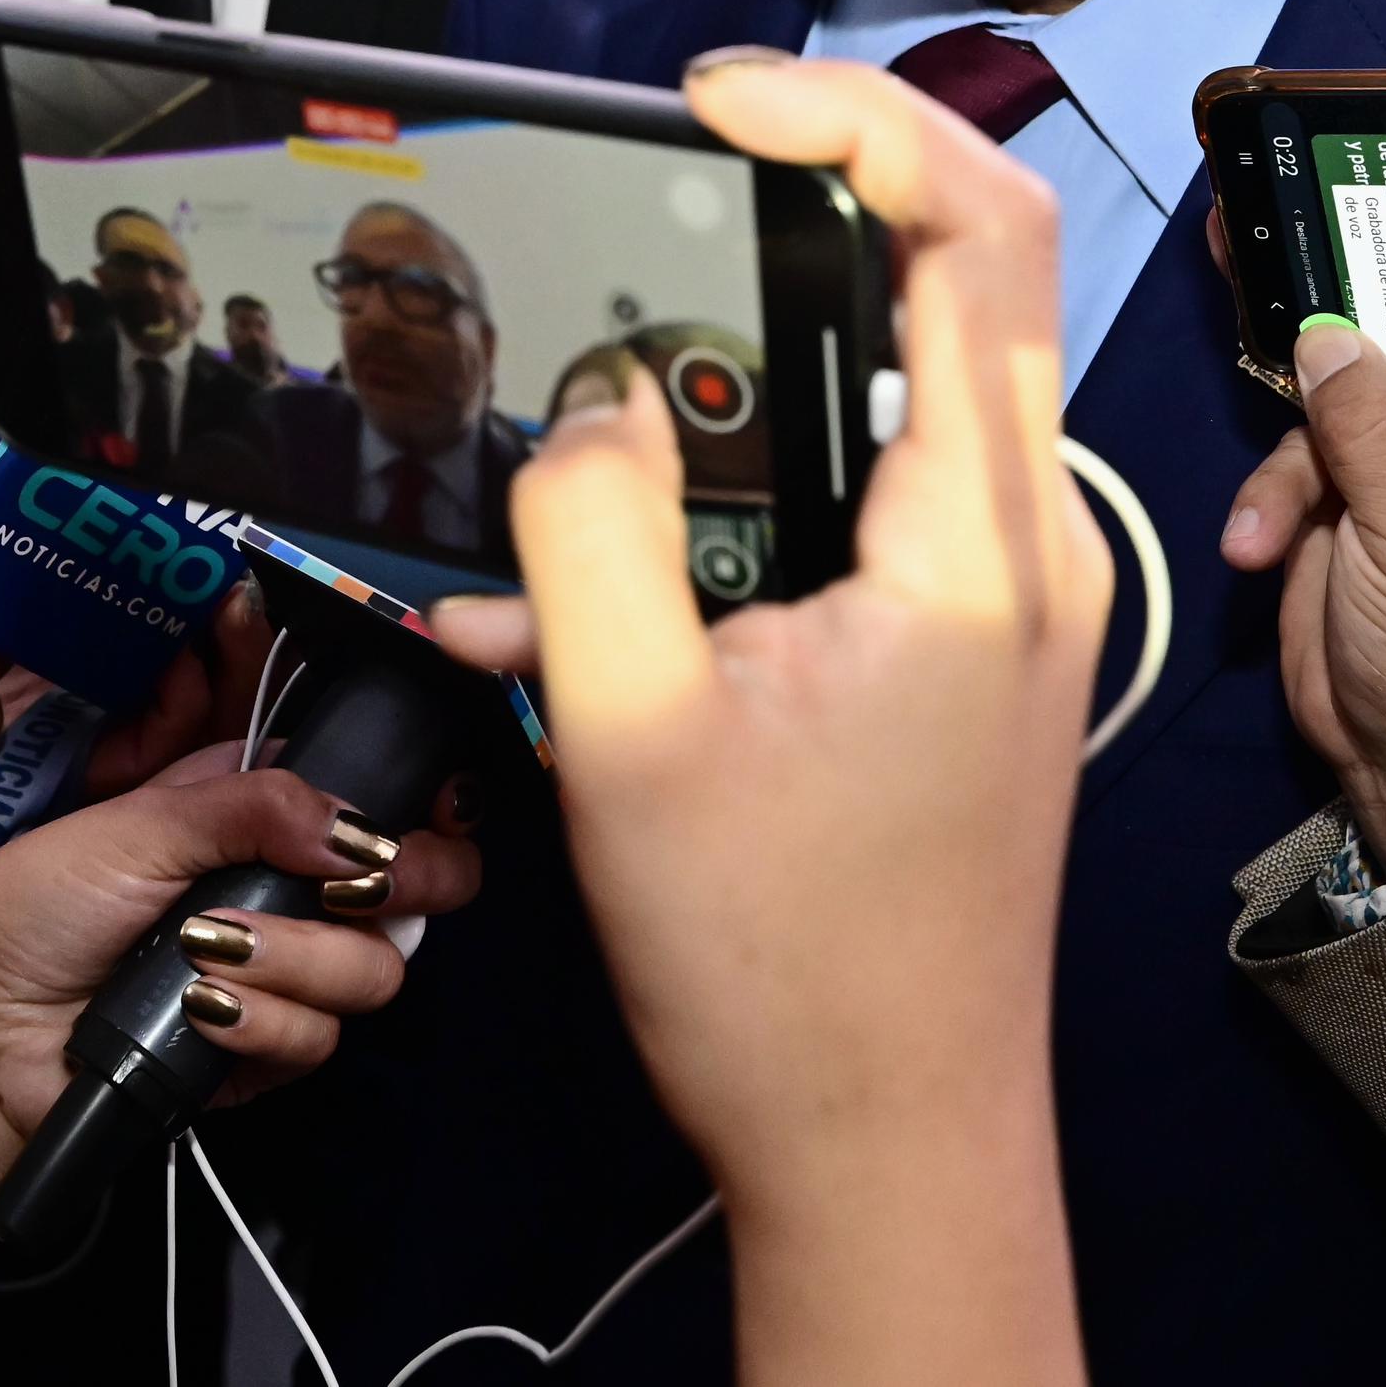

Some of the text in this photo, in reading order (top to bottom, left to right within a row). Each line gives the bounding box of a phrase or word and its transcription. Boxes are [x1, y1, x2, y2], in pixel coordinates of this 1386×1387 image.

[1273, 136, 1299, 177] 0:22
[1344, 141, 1363, 151] y
[1344, 197, 1362, 239] de voz
[1365, 197, 1386, 265] Grabadora
[1295, 221, 1320, 307] Desliza para cancelar
[18, 465, 226, 605] CERO
